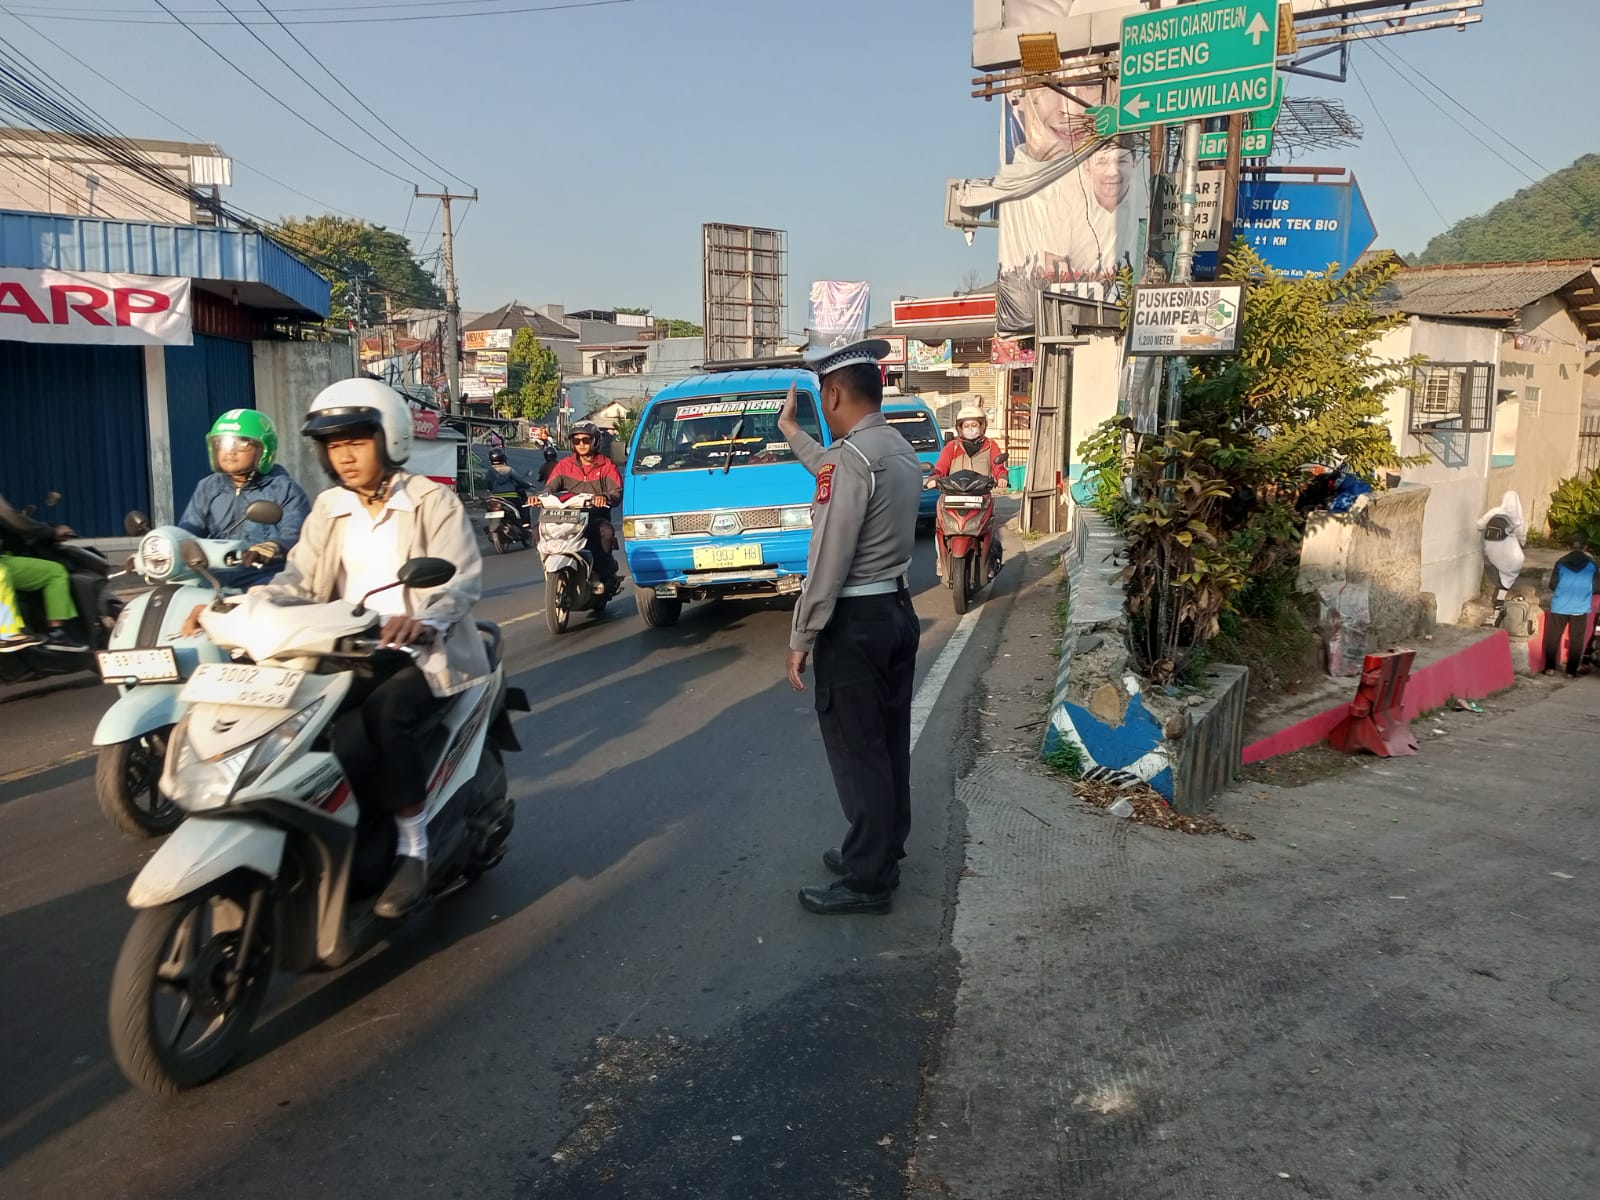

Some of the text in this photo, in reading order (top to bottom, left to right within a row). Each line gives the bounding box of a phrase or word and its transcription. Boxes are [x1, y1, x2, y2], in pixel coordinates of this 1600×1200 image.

[1124, 5, 1247, 47] PRASASTI CIARUTEUN
[1123, 42, 1210, 77] CISEENG
[1156, 77, 1267, 113] LEUWILIANG
[1252, 199, 1290, 211] SITUS
[1254, 218, 1282, 230] HOK
[1286, 218, 1312, 231] TEK
[1315, 219, 1338, 231] BIO
[1272, 236, 1288, 246] KM
[1138, 290, 1210, 309] PUSKESMAS
[1136, 310, 1200, 326] CIAMPEA
[1156, 335, 1175, 346] METER
[711, 549, 735, 562] 1993
[216, 667, 260, 684] 3002
